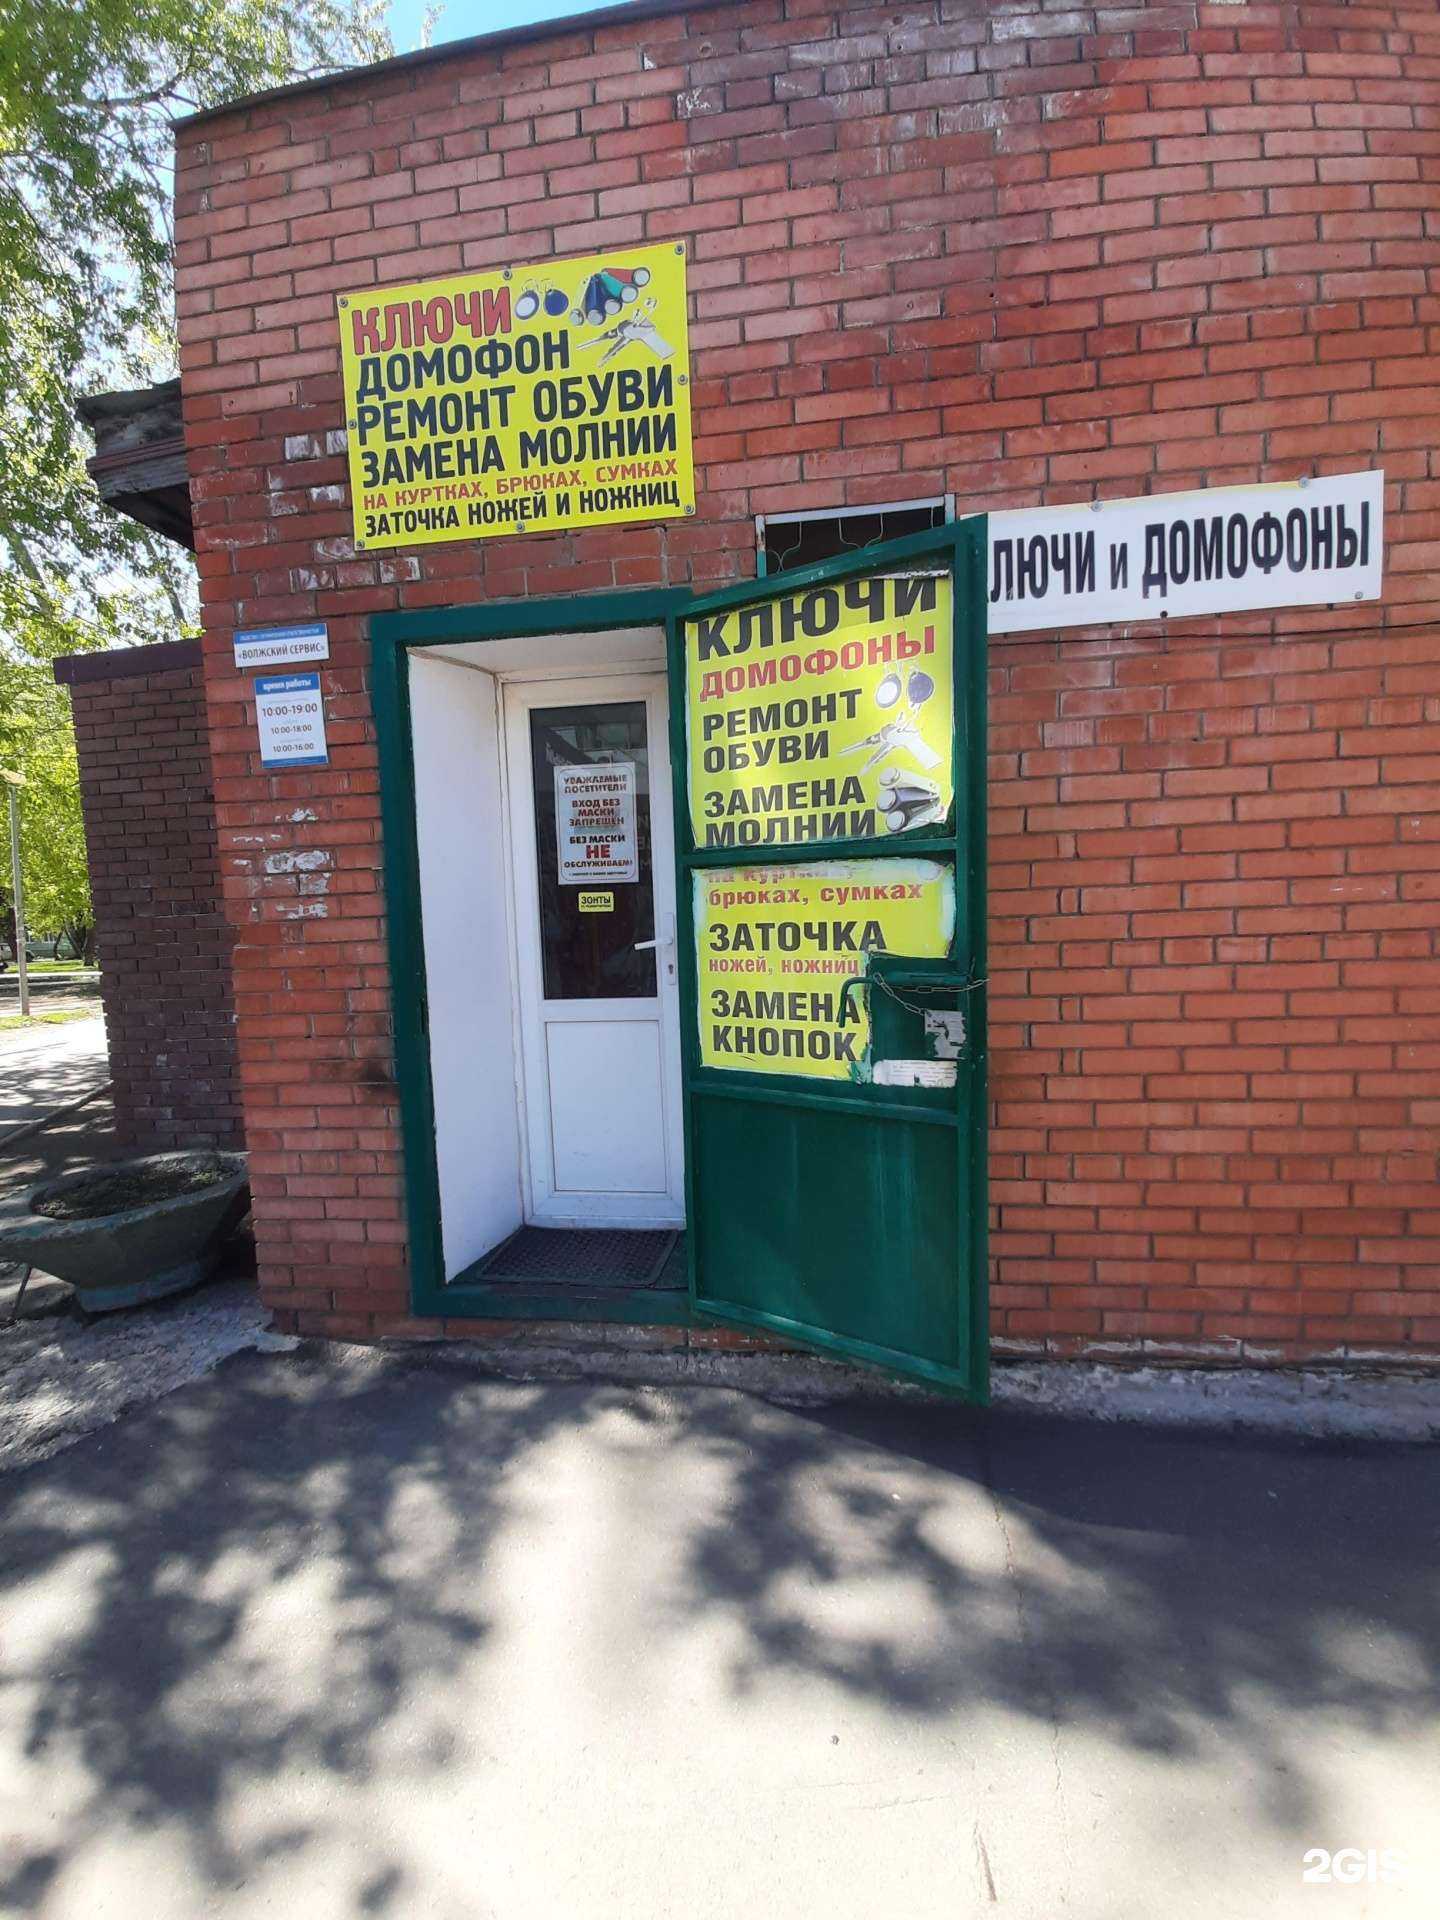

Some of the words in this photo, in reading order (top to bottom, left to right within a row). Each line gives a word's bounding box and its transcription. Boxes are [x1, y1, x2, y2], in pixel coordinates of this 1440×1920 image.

[352, 286, 511, 355] КЛЮЧИ
[356, 330, 570, 403] ДОМОФОН
[357, 385, 515, 446] РЕМОНТ
[533, 364, 673, 422] ОБУВИ
[361, 435, 505, 488] ЗАМЕНА
[519, 413, 676, 469] МОЛНИИ
[364, 492, 388, 510] НА
[395, 481, 488, 507] КУРТКАХ,
[496, 470, 587, 495] БРЮКАХ,
[595, 458, 678, 483] СУМКАХ
[365, 504, 460, 537] ЗАТОЧКА
[468, 490, 546, 526] НОЖЕЙ
[556, 493, 570, 515] И
[579, 480, 680, 514] НОЖНИЦ
[988, 530, 1096, 603] ЛЮЧИ
[1142, 501, 1370, 599] ДОМОФОНЫ
[697, 578, 936, 661] КЛЮЧИ
[699, 626, 935, 703] ДОМОФОНЫ
[703, 688, 863, 741] РЕМОНТ
[703, 730, 829, 774] ОБУВИ
[564, 774, 627, 785] УВАЖАЕМЫЕ
[564, 784, 627, 794] ПОСЕТИТЕЛИ
[704, 776, 866, 817] ЗАМЕНА
[572, 799, 600, 809] ВХОД
[602, 798, 620, 807] БЕЗ
[578, 808, 614, 817] МАСКИ
[570, 836, 587, 844] БЕЗ
[589, 834, 625, 844] МАСКИ
[705, 809, 876, 848] МОЛНИИ
[586, 845, 610, 859] НЕ
[581, 895, 611, 904] ЗОНТЫ
[708, 888, 808, 909] брюках,
[820, 884, 923, 906] сумках
[709, 920, 887, 952] ЗАТОЧКА
[709, 956, 773, 975] ножей,
[781, 957, 860, 976] ножниц
[711, 989, 860, 1024] ЗАМЕНА
[712, 1024, 857, 1061] КНОПОК
